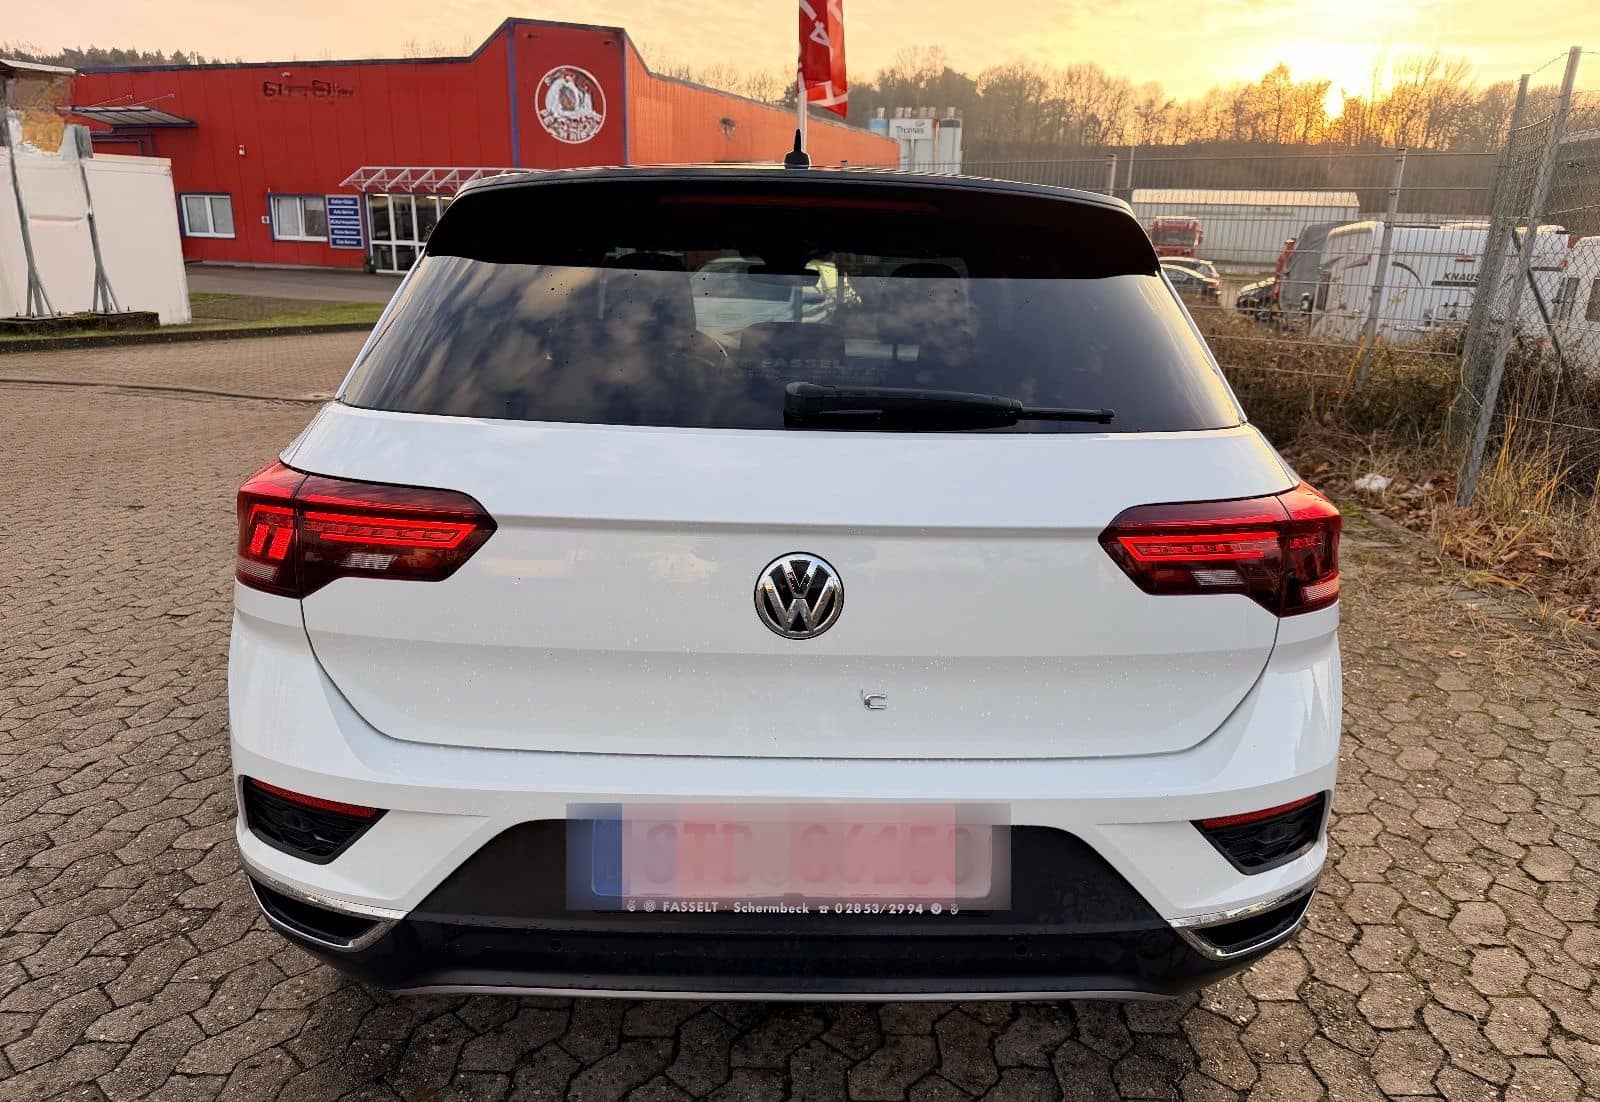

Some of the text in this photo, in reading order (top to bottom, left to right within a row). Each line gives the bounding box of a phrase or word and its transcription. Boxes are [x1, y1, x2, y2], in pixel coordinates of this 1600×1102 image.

[1443, 272, 1481, 281] KNAUS
[757, 554, 841, 638] VW
[663, 901, 719, 912] FASSELT
[733, 902, 810, 913] Schermbeck
